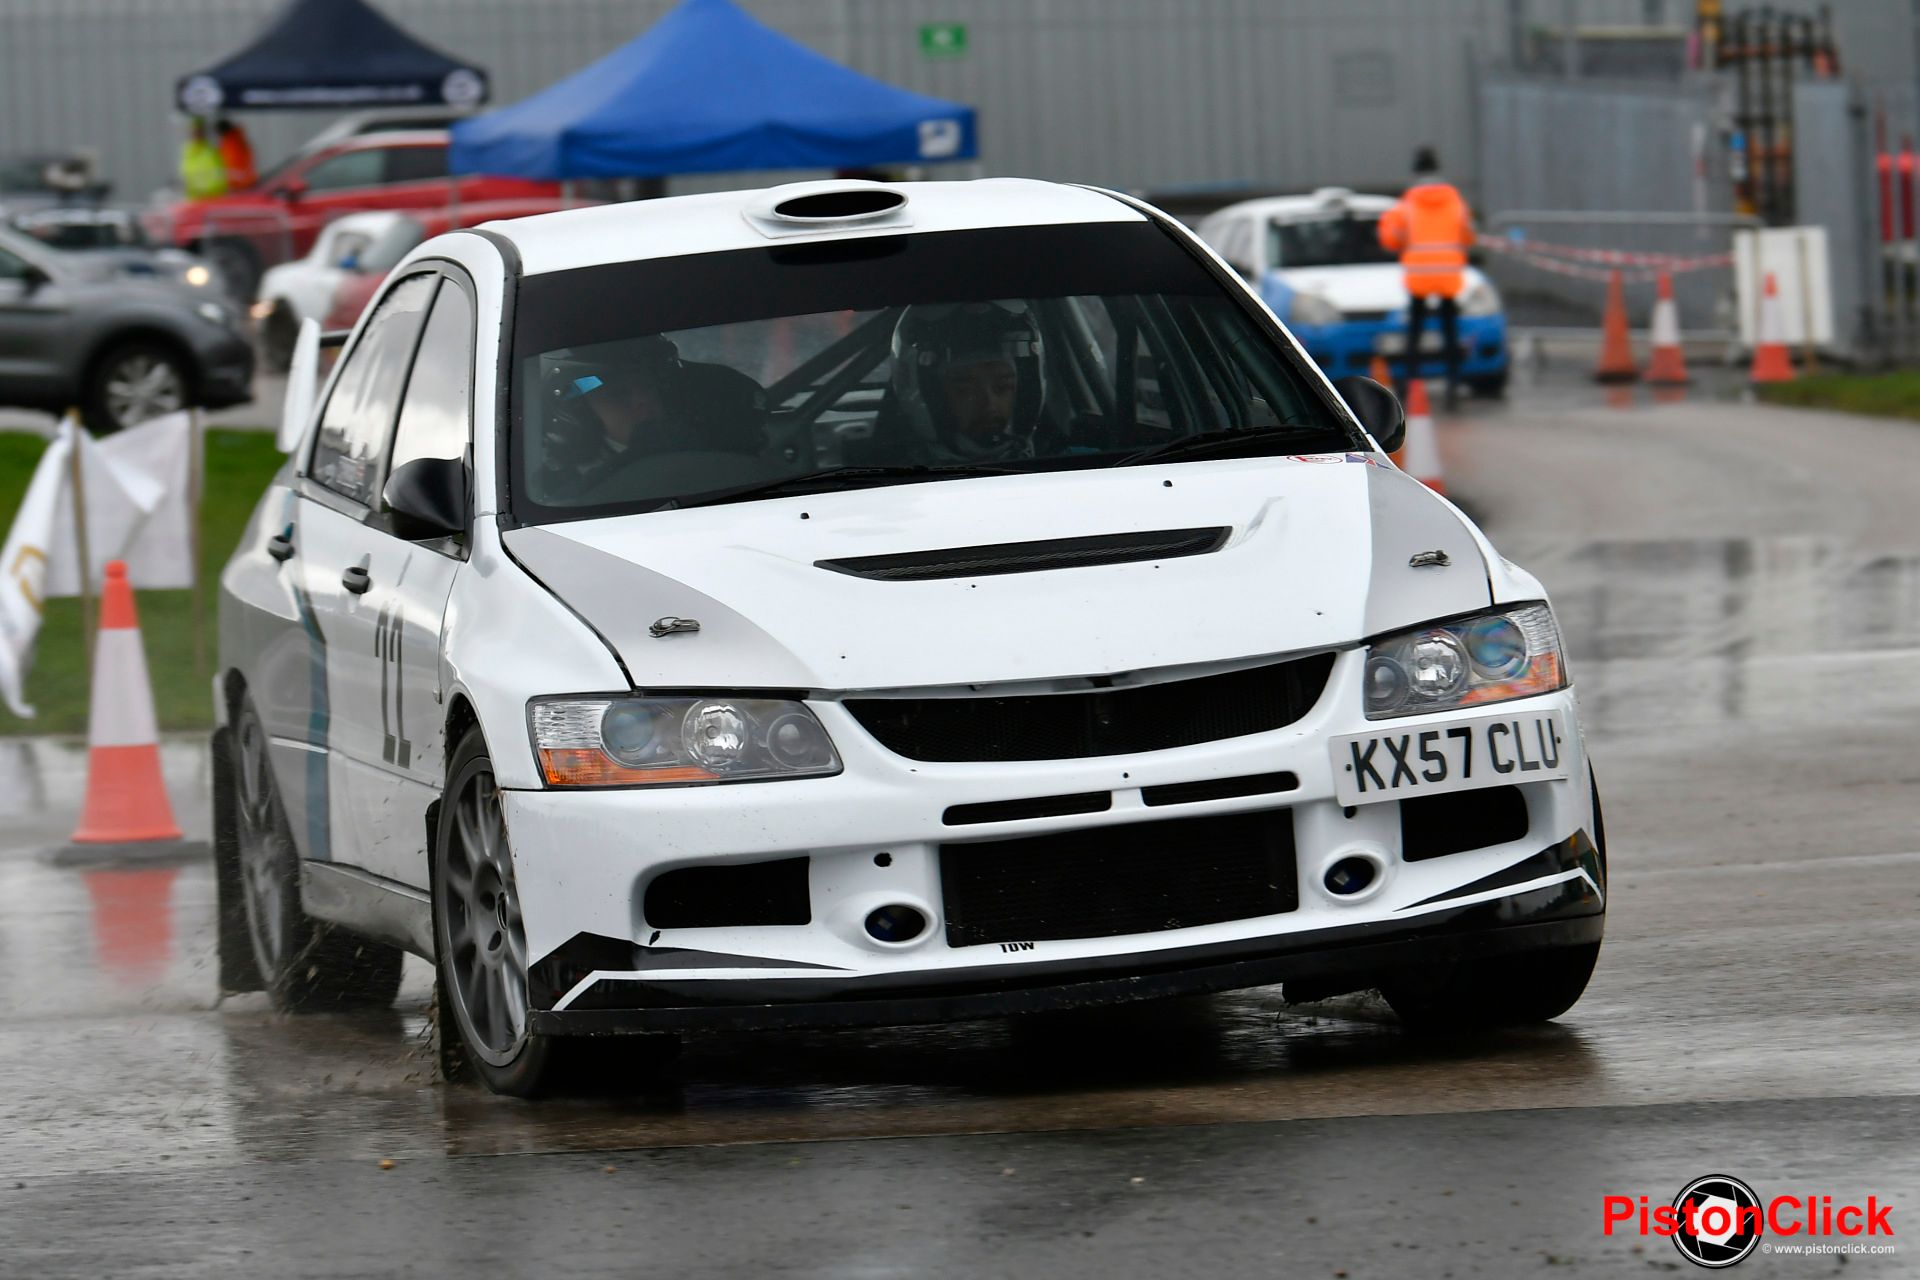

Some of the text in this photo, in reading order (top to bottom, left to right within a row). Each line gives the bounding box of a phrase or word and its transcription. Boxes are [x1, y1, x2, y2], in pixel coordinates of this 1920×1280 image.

[1350, 718, 1559, 793] KX57 CLU
[999, 942, 1035, 953] TOW
